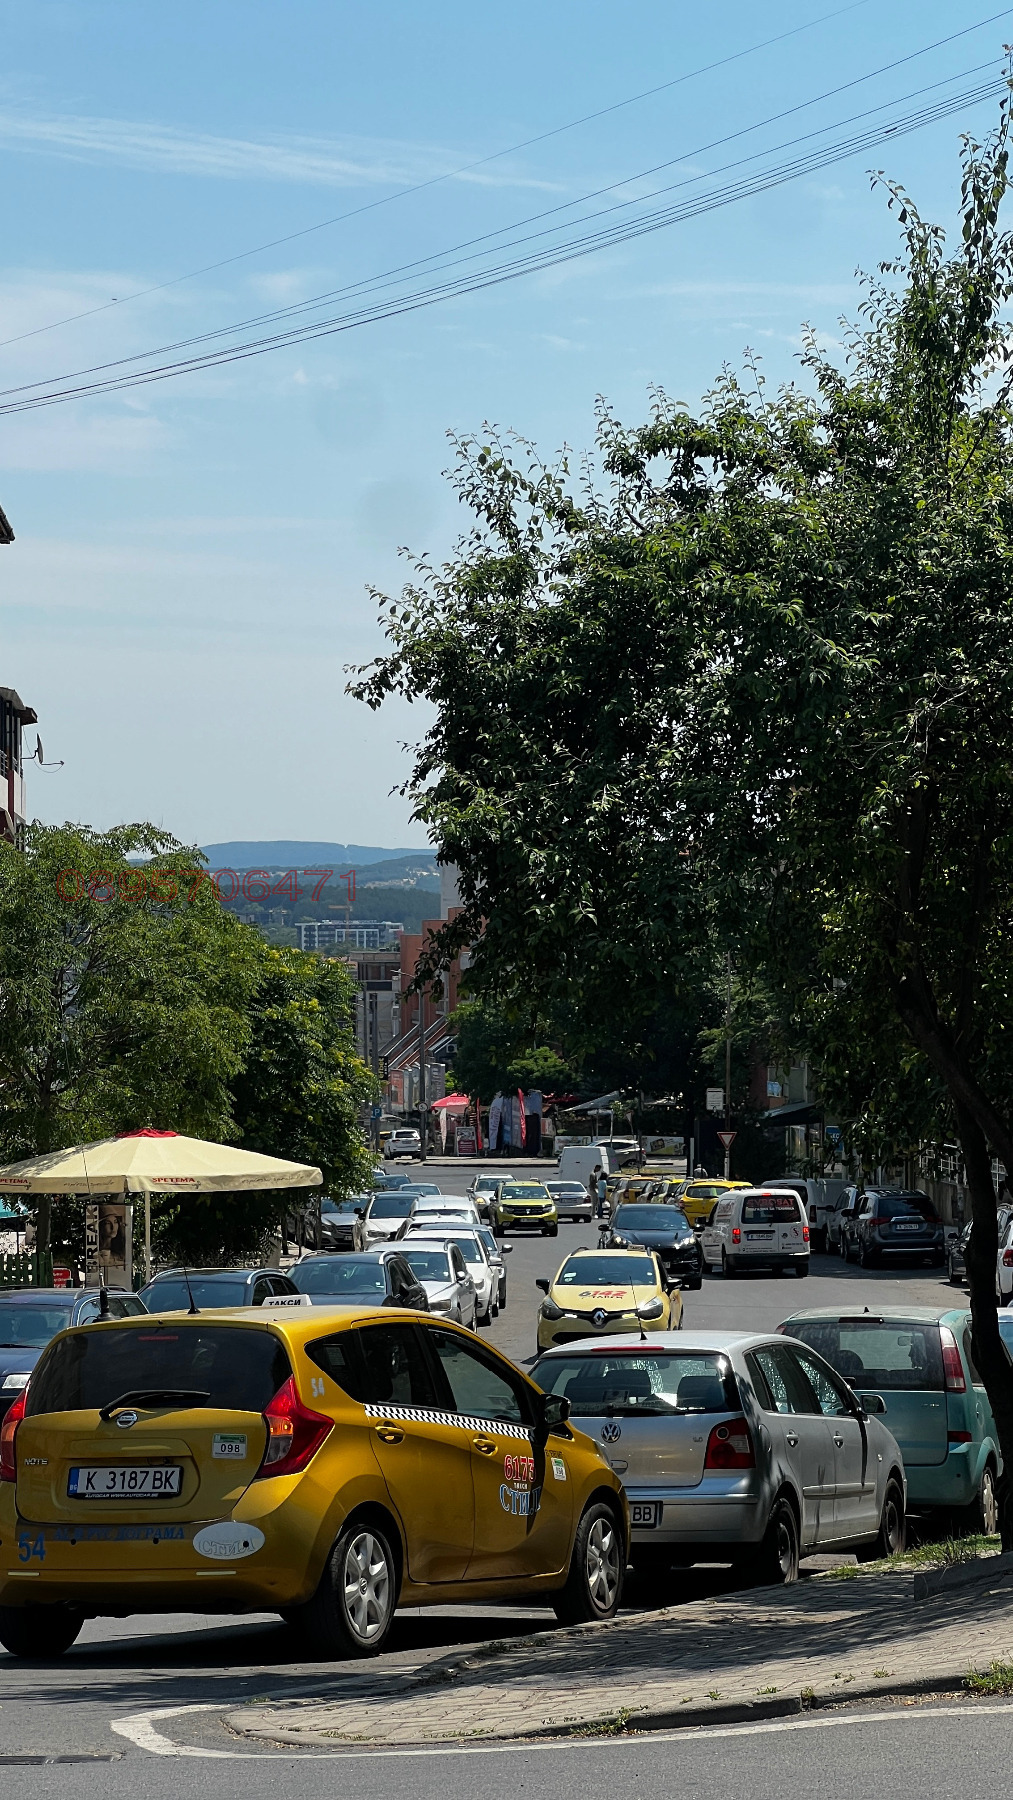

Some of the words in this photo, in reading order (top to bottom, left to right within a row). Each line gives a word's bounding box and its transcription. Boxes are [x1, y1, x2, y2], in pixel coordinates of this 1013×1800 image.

[86, 1206, 98, 1273] BREAK
[268, 1298, 301, 1306] ТАКСИ
[220, 1443, 240, 1453] 098
[504, 1454, 536, 1482] 6173
[85, 1471, 98, 1490] K
[633, 1506, 652, 1522] BB
[18, 1531, 46, 1563] 54
